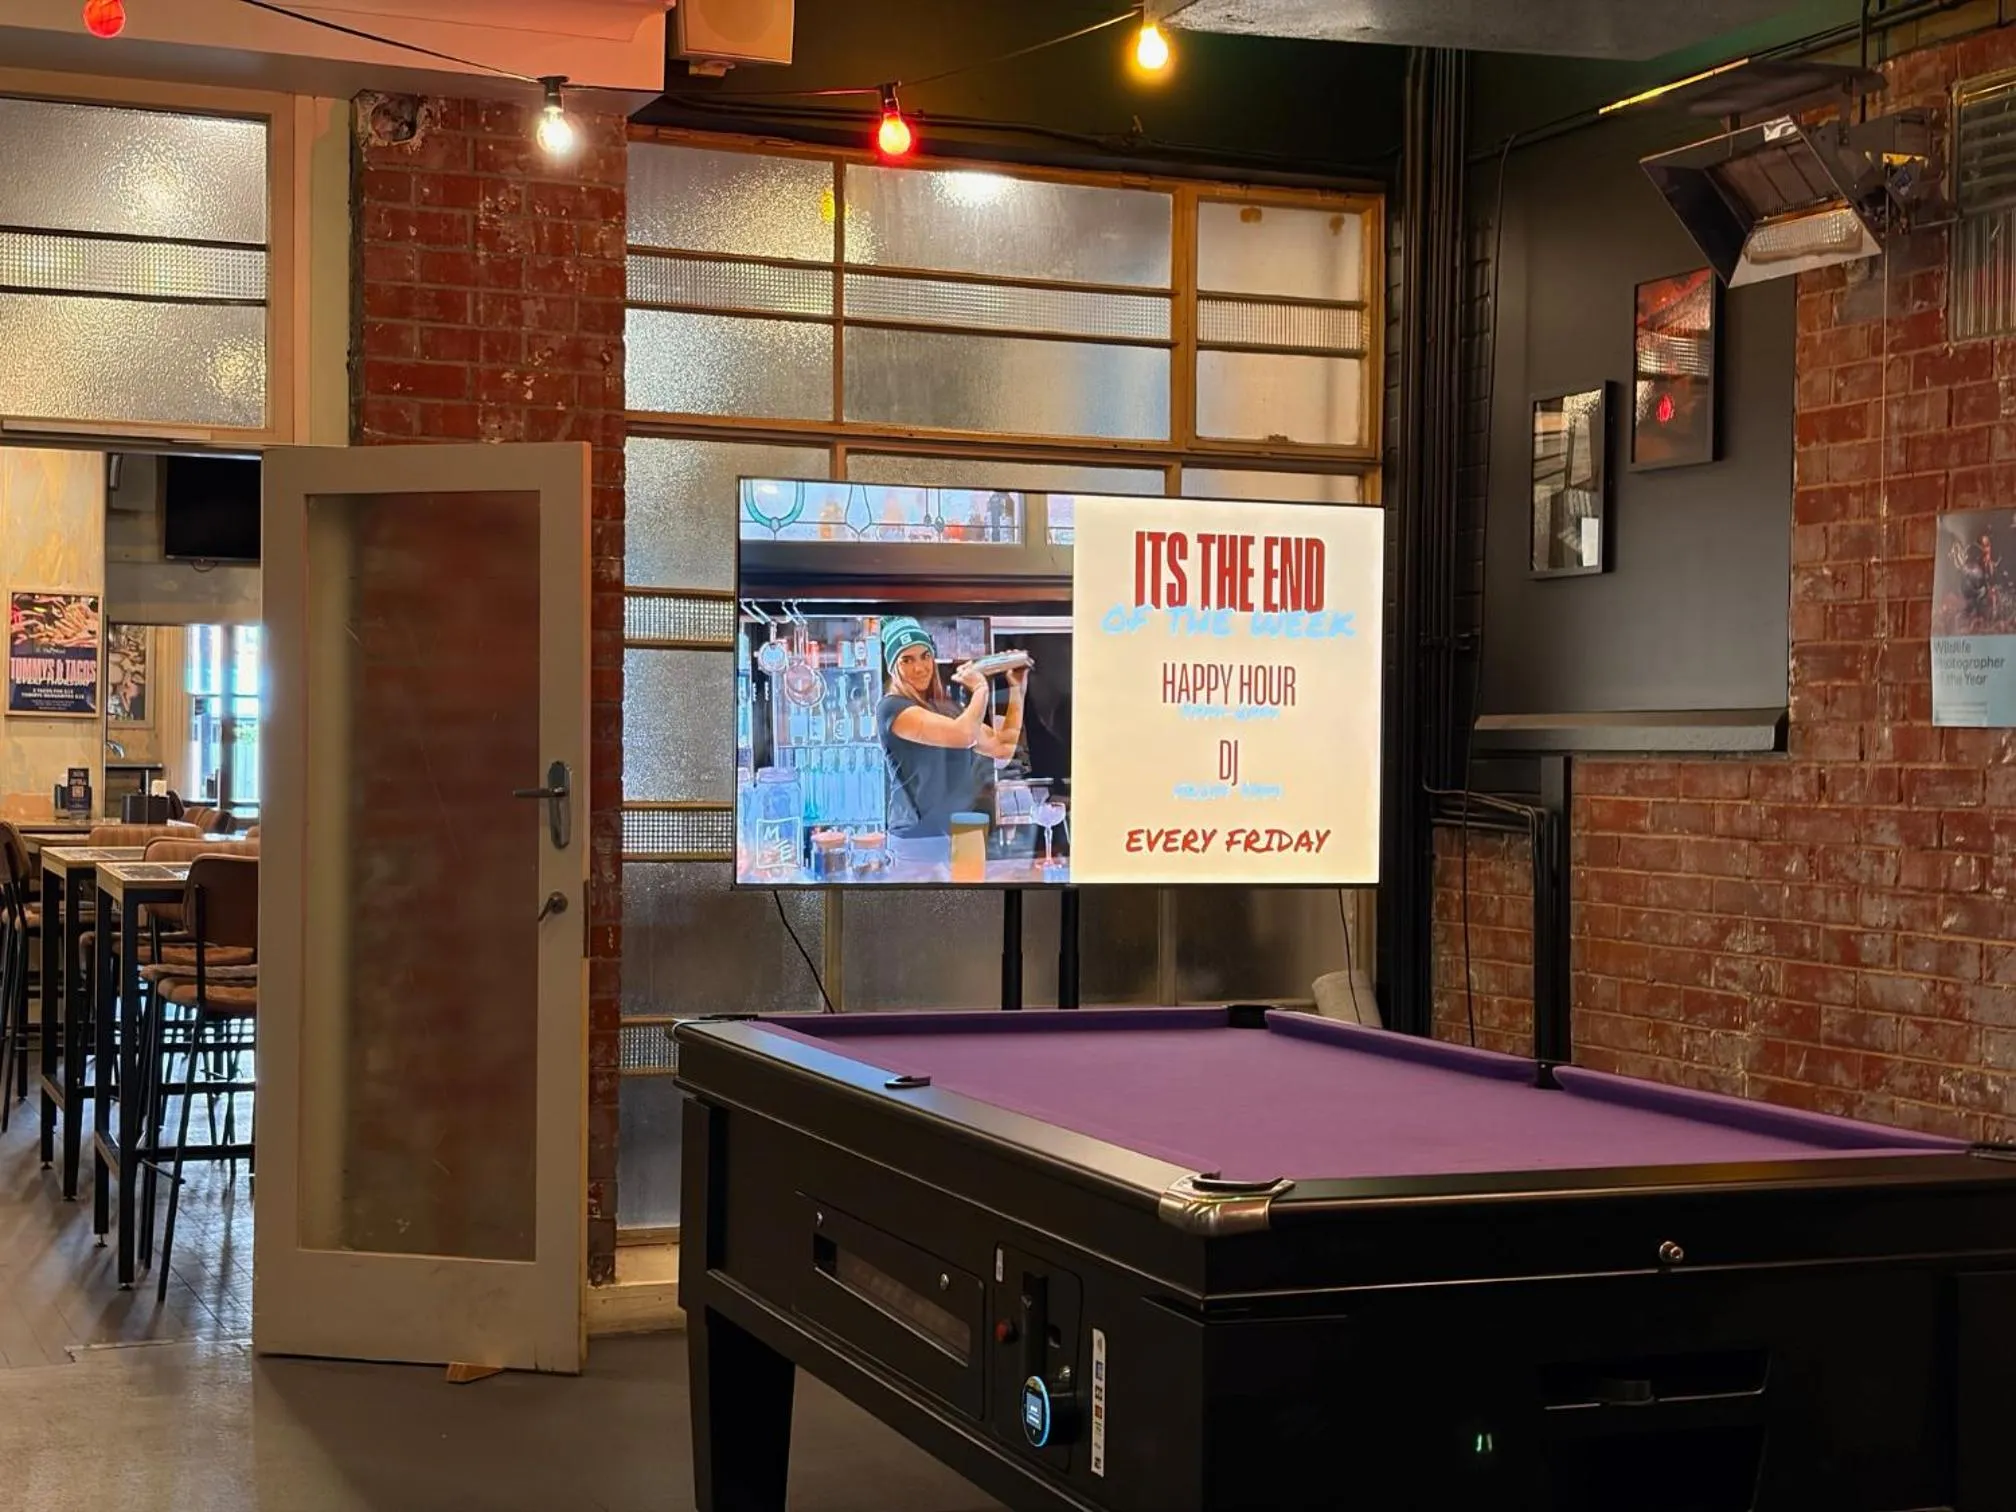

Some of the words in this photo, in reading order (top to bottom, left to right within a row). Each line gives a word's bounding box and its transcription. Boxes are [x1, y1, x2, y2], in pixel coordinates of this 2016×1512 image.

[1135, 531, 1188, 609] ITS
[1197, 533, 1255, 612] THE
[1263, 536, 1325, 613] END
[1102, 603, 1149, 634] OF
[1168, 605, 1234, 636] THE
[1251, 609, 1356, 638] WEEK
[1934, 656, 2005, 670] otographer
[1162, 662, 1234, 704] HAPPY
[1239, 664, 1296, 706] HOUR
[1219, 740, 1238, 786] DJ
[1125, 829, 1217, 854] EVERY
[1225, 829, 1332, 854] FRIDAY
